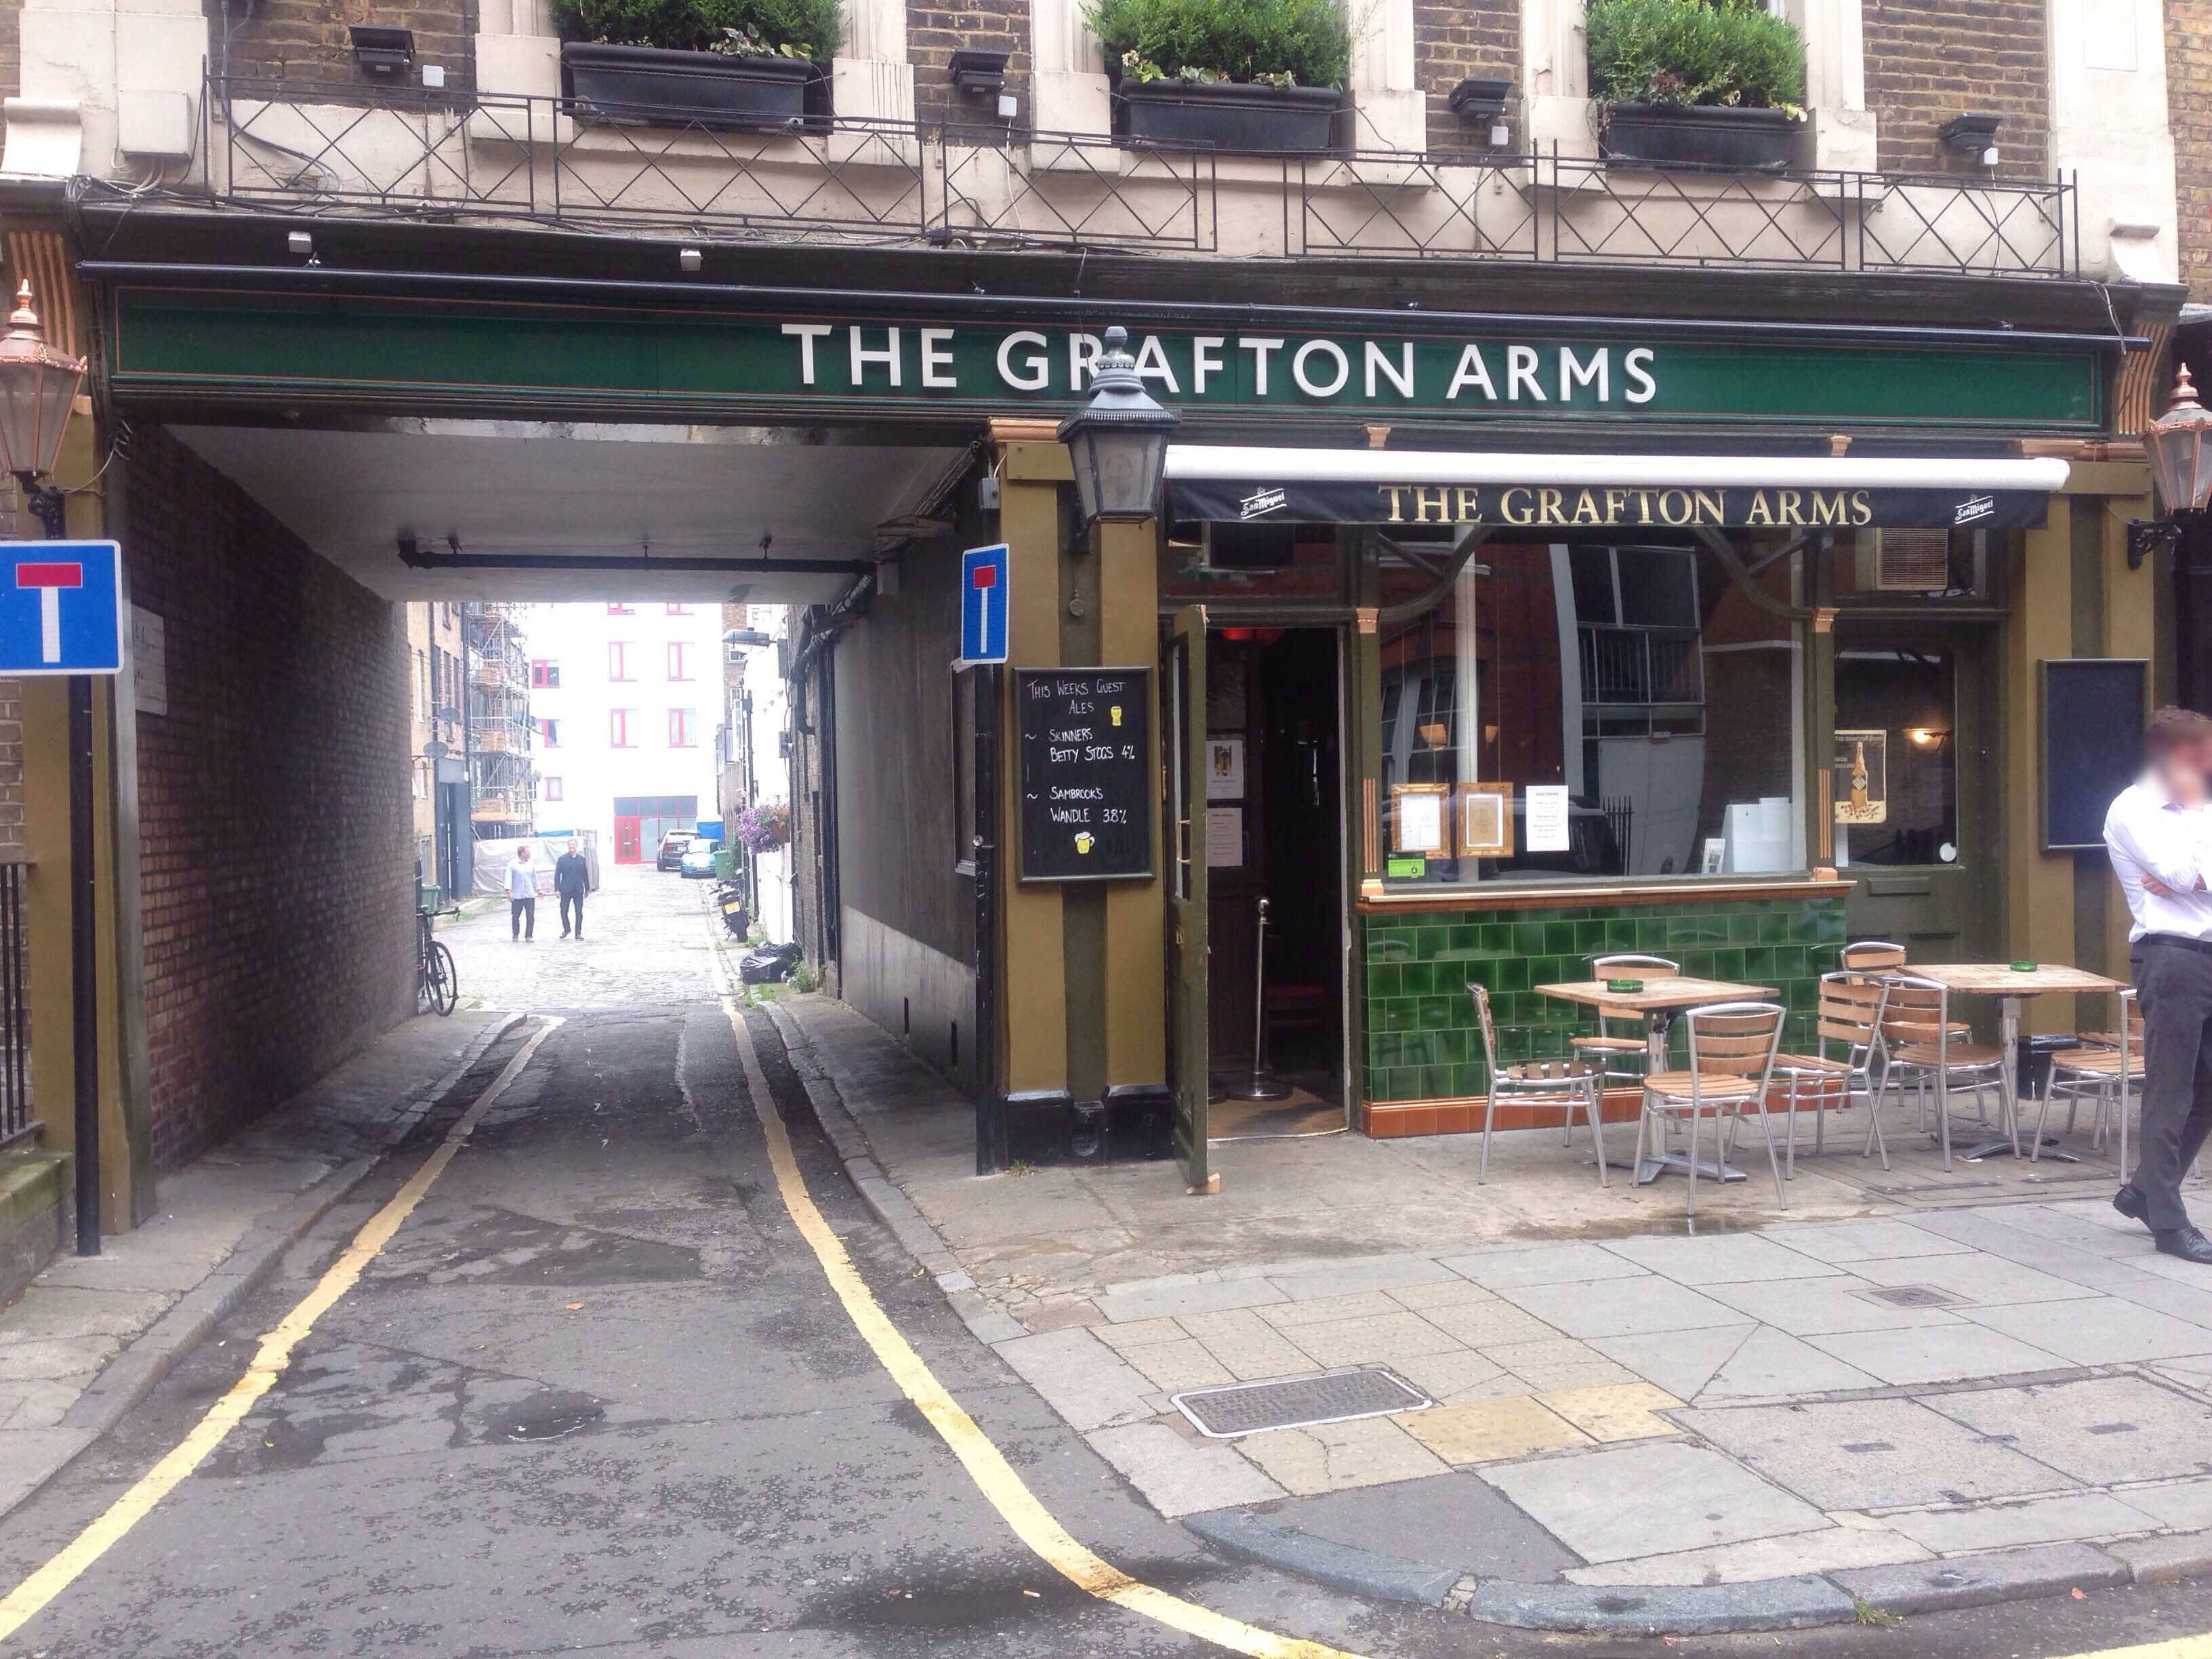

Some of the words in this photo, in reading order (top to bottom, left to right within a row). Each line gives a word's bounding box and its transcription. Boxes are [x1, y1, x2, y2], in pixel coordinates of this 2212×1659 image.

[781, 323, 957, 388] THE
[997, 331, 1414, 398] GRAFTON
[1446, 344, 1657, 404] ARMS
[1378, 485, 1483, 523] THE
[1500, 487, 1727, 526] GRAFTON
[1745, 489, 1871, 527] ARMS
[1027, 679, 1050, 699] THIS
[1057, 680, 1088, 696] WEEKS
[1097, 678, 1126, 693] GUEST
[1069, 699, 1094, 715] ALES
[1048, 728, 1092, 742] SKINNERS
[1050, 747, 1079, 762] BETTY
[1050, 807, 1090, 823] WANDLE
